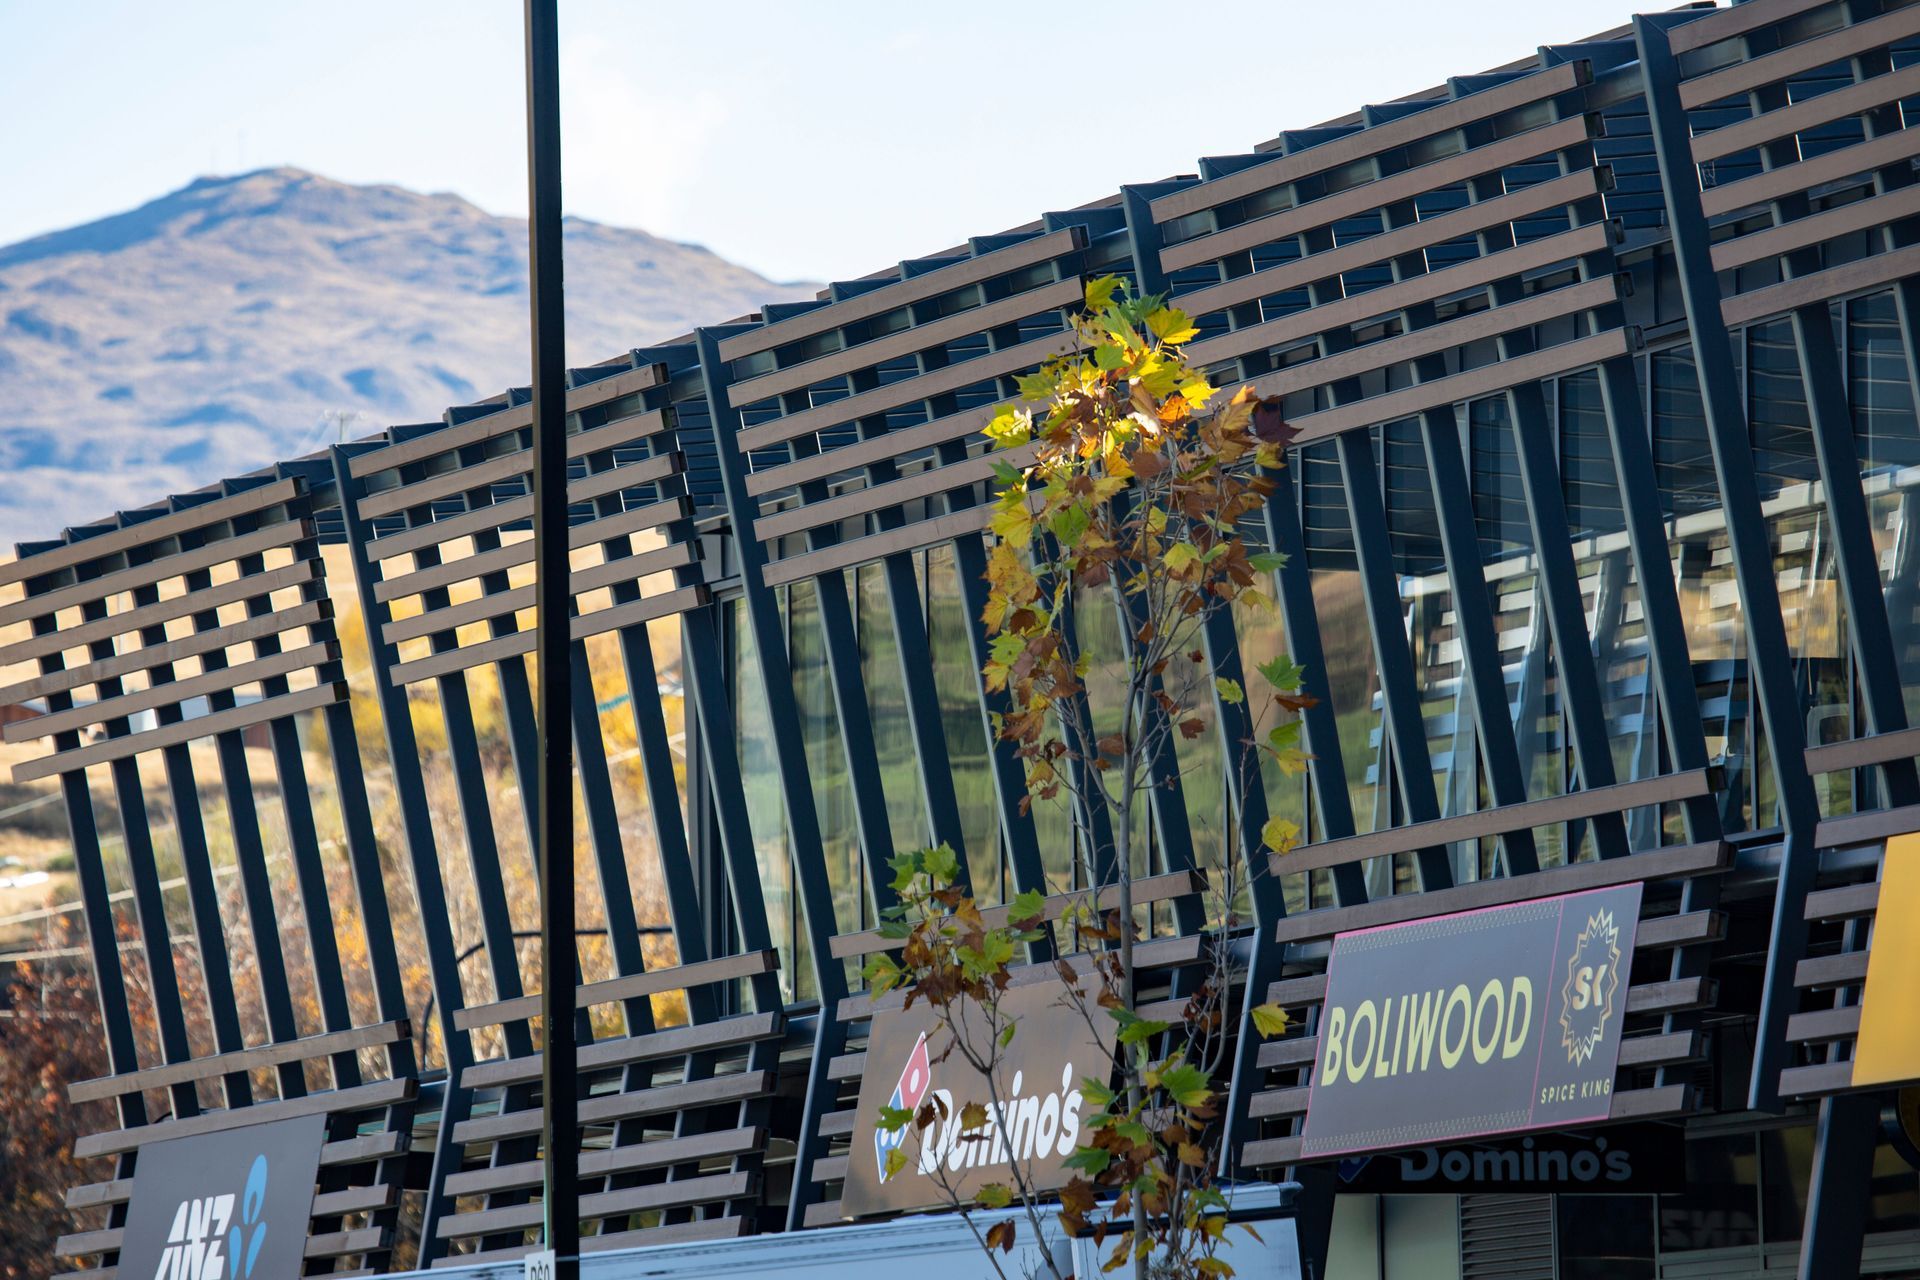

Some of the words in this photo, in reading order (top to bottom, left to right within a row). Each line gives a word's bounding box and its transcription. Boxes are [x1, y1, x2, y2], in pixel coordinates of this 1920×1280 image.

[1321, 976, 1533, 1087] BOLIWOOD
[1541, 1083, 1576, 1104] SPICE
[1581, 1078, 1610, 1099] KING
[1402, 1138, 1632, 1181] Domino's
[154, 1193, 235, 1280] ANZ
